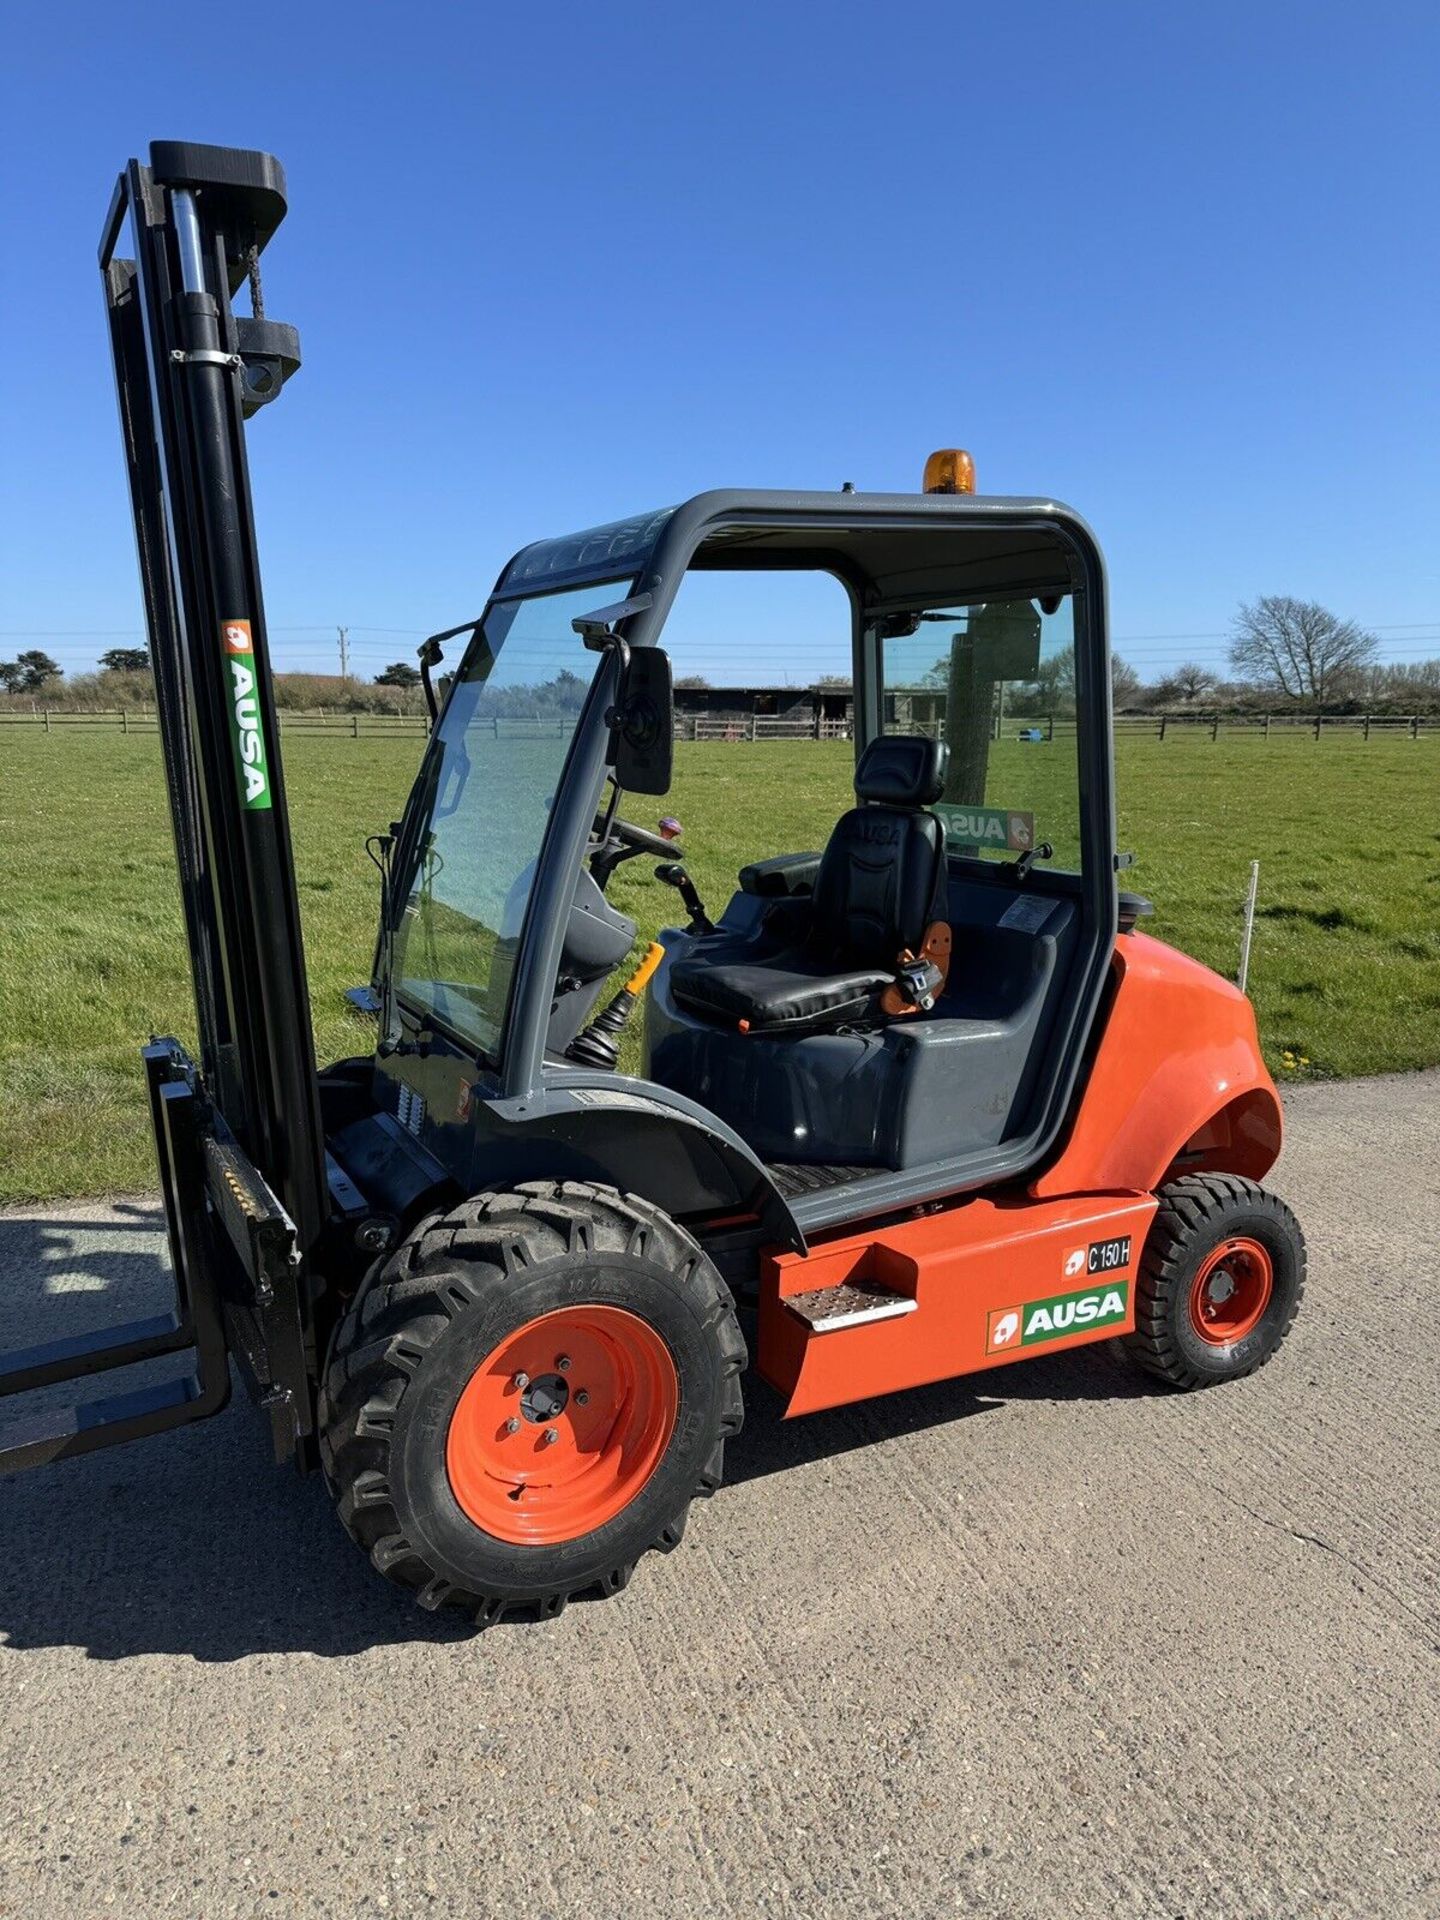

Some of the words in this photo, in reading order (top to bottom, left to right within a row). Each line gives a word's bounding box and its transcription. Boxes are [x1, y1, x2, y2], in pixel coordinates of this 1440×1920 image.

[231, 660, 266, 803] AUSA
[1088, 1247, 1098, 1271] C
[1101, 1243, 1119, 1268] 150
[1121, 1240, 1131, 1264] H
[1024, 1291, 1125, 1336] AUSA
